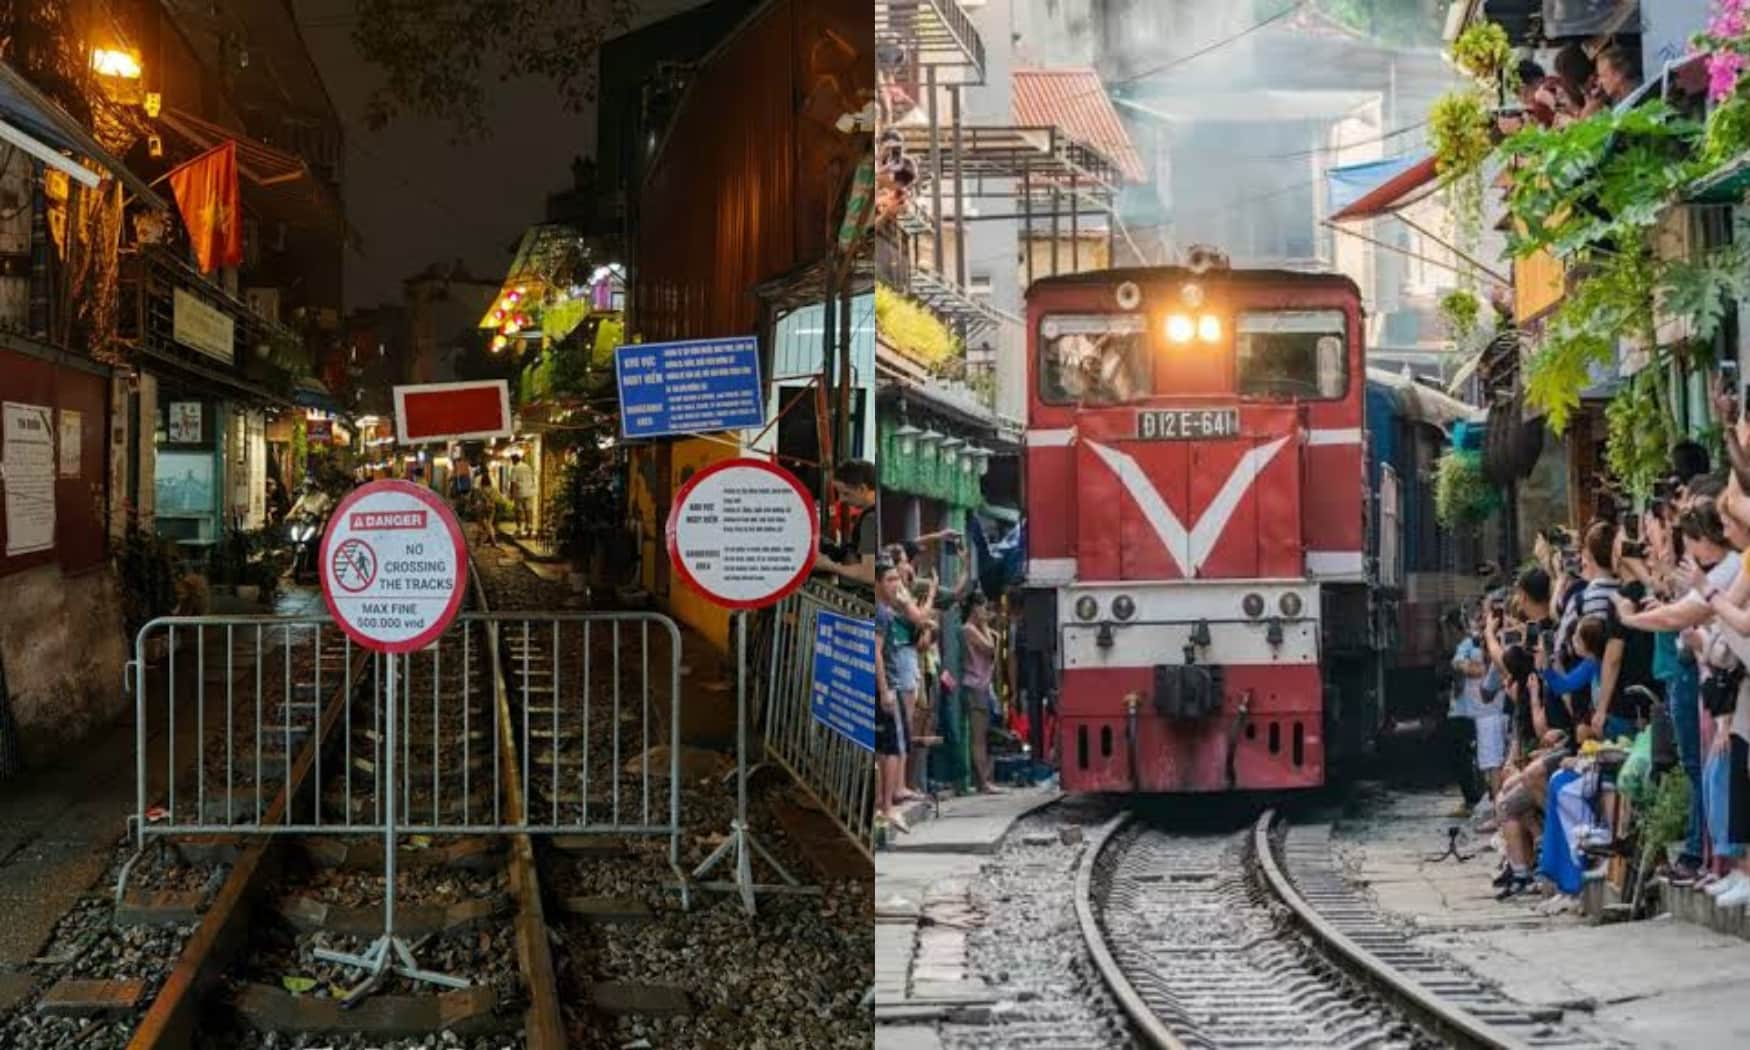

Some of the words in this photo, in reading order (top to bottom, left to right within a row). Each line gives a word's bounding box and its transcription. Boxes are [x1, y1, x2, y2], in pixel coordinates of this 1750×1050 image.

[365, 513, 422, 528] DANGER
[405, 543, 424, 555] NO
[384, 561, 446, 574] CROSSING
[379, 578, 402, 590] THE
[405, 577, 453, 590] TRACKS
[362, 603, 388, 614] MAX
[391, 603, 418, 614] FINE
[357, 617, 400, 628] 500.000
[403, 618, 425, 628] vnd
